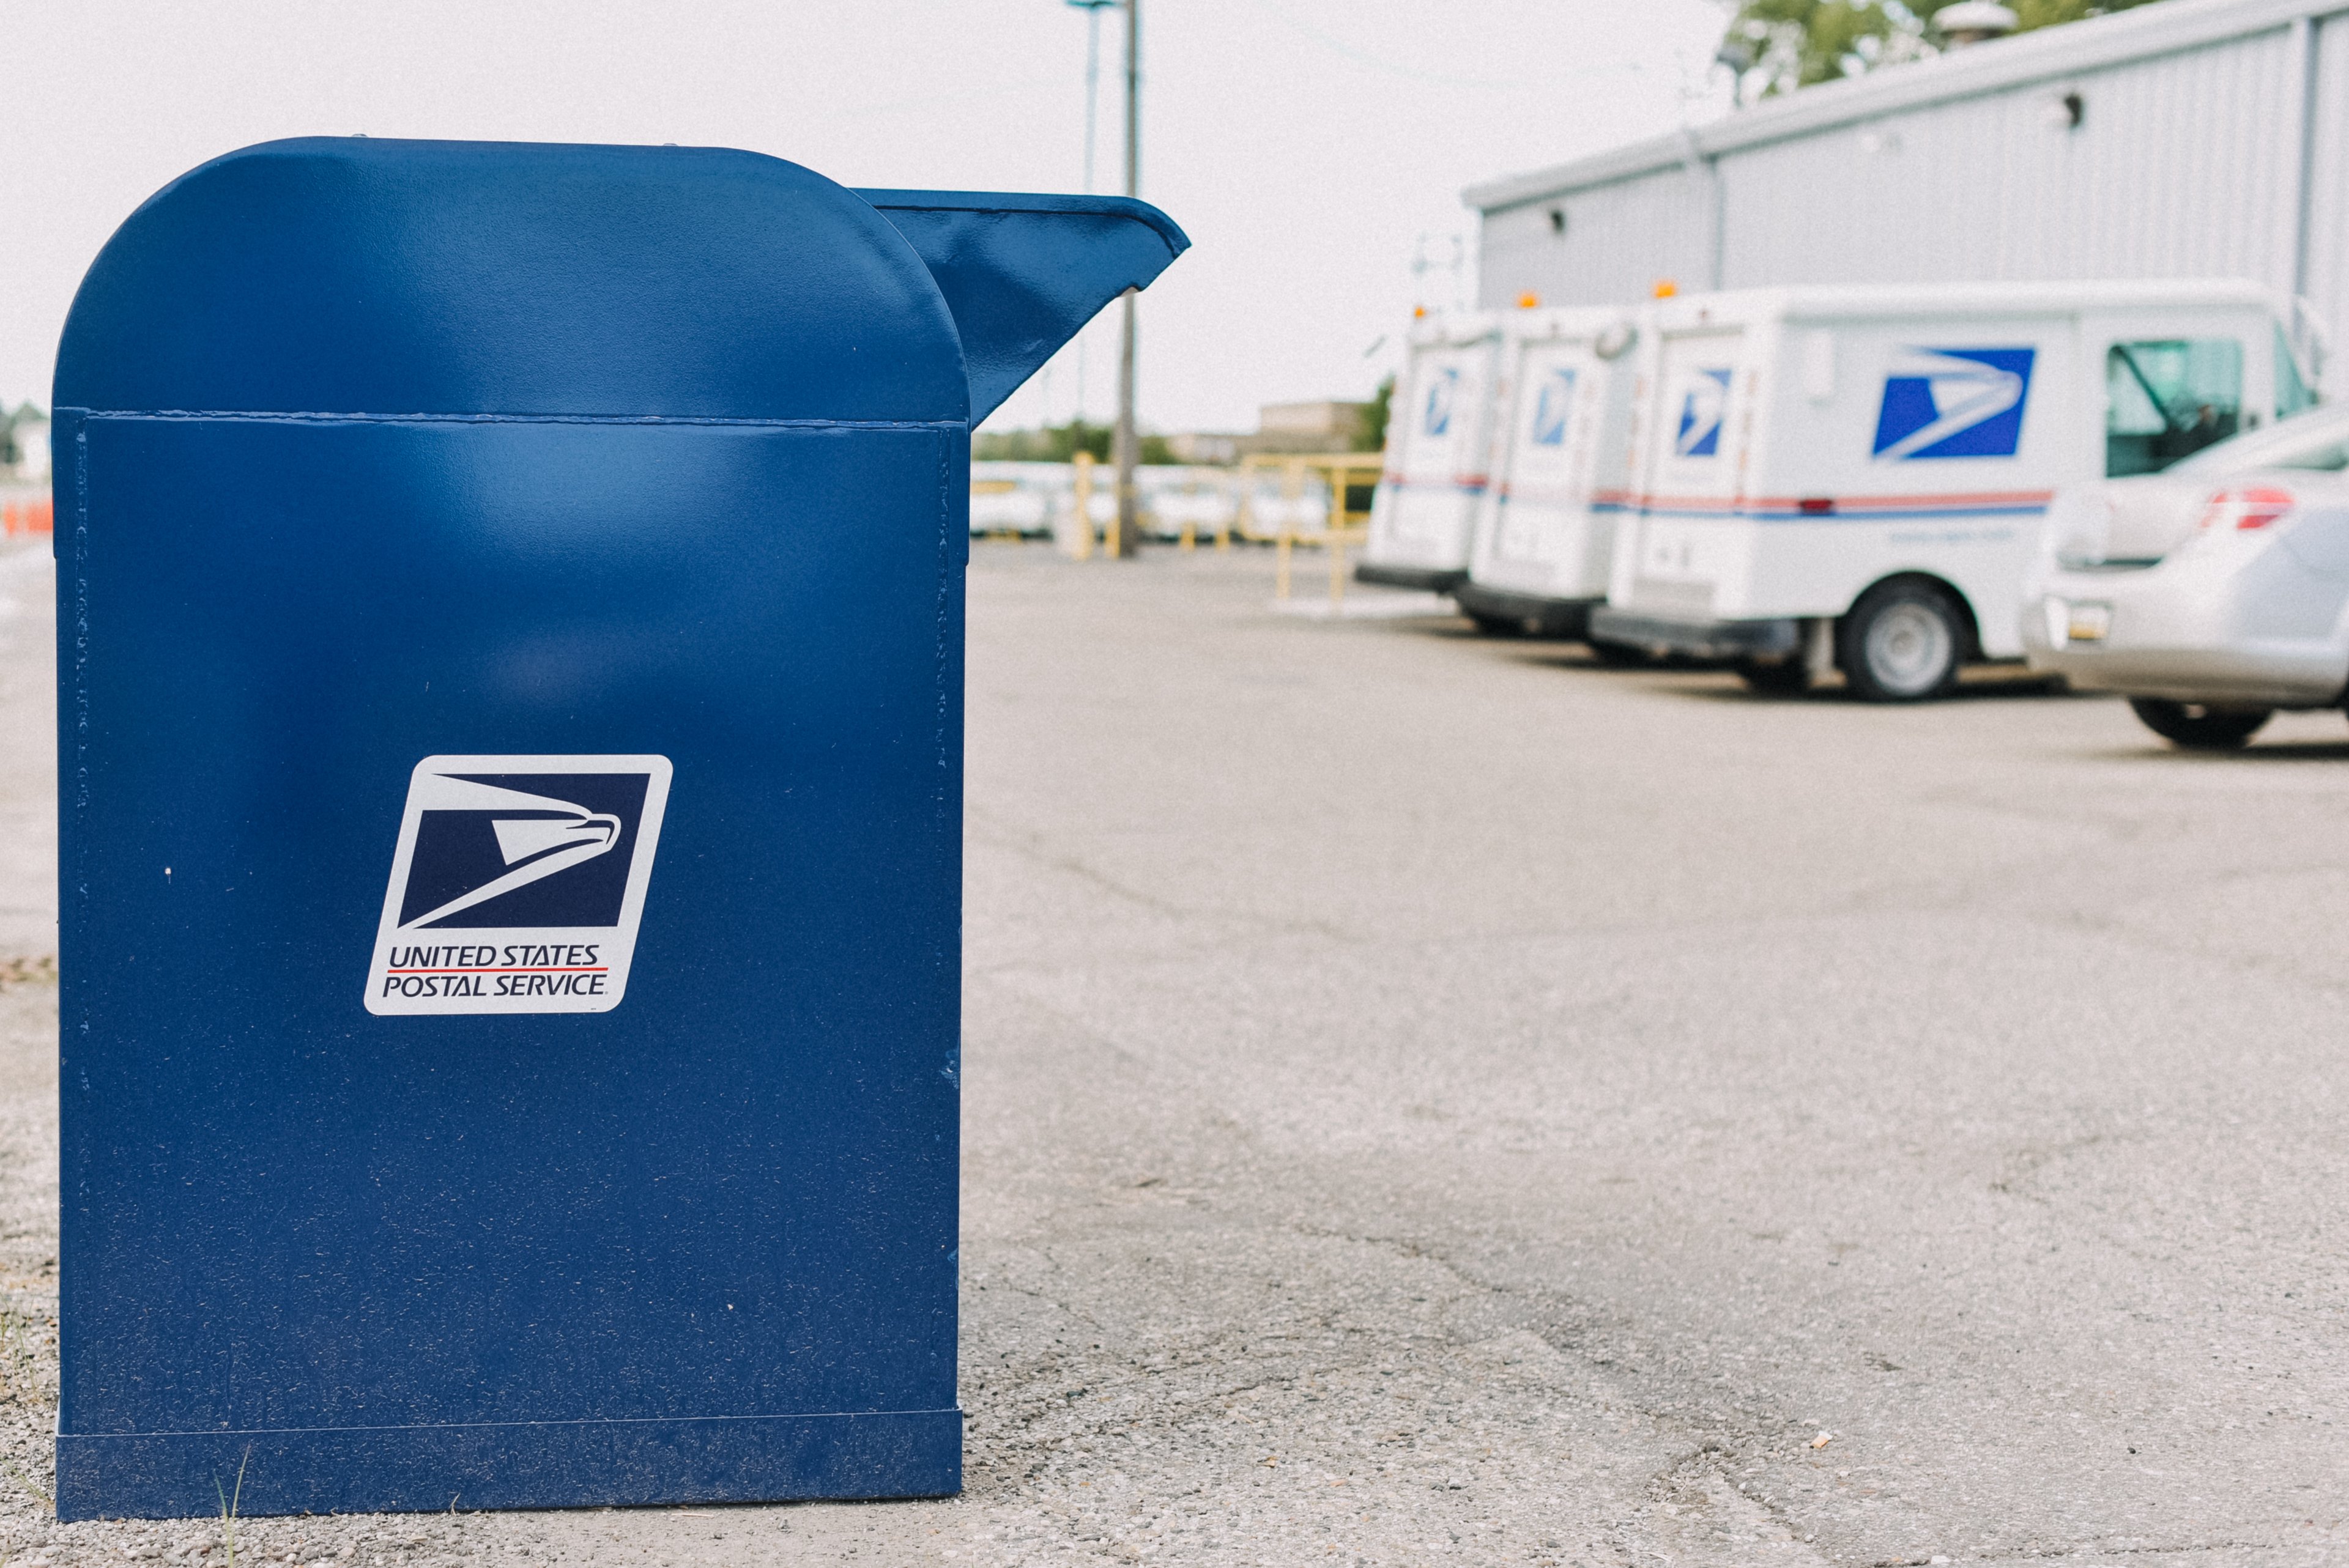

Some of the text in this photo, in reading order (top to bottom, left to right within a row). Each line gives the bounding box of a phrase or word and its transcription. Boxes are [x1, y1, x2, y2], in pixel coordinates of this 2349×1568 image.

[389, 944, 599, 968] UNITED STATES
[382, 974, 607, 997] POSTAL SERVICE
